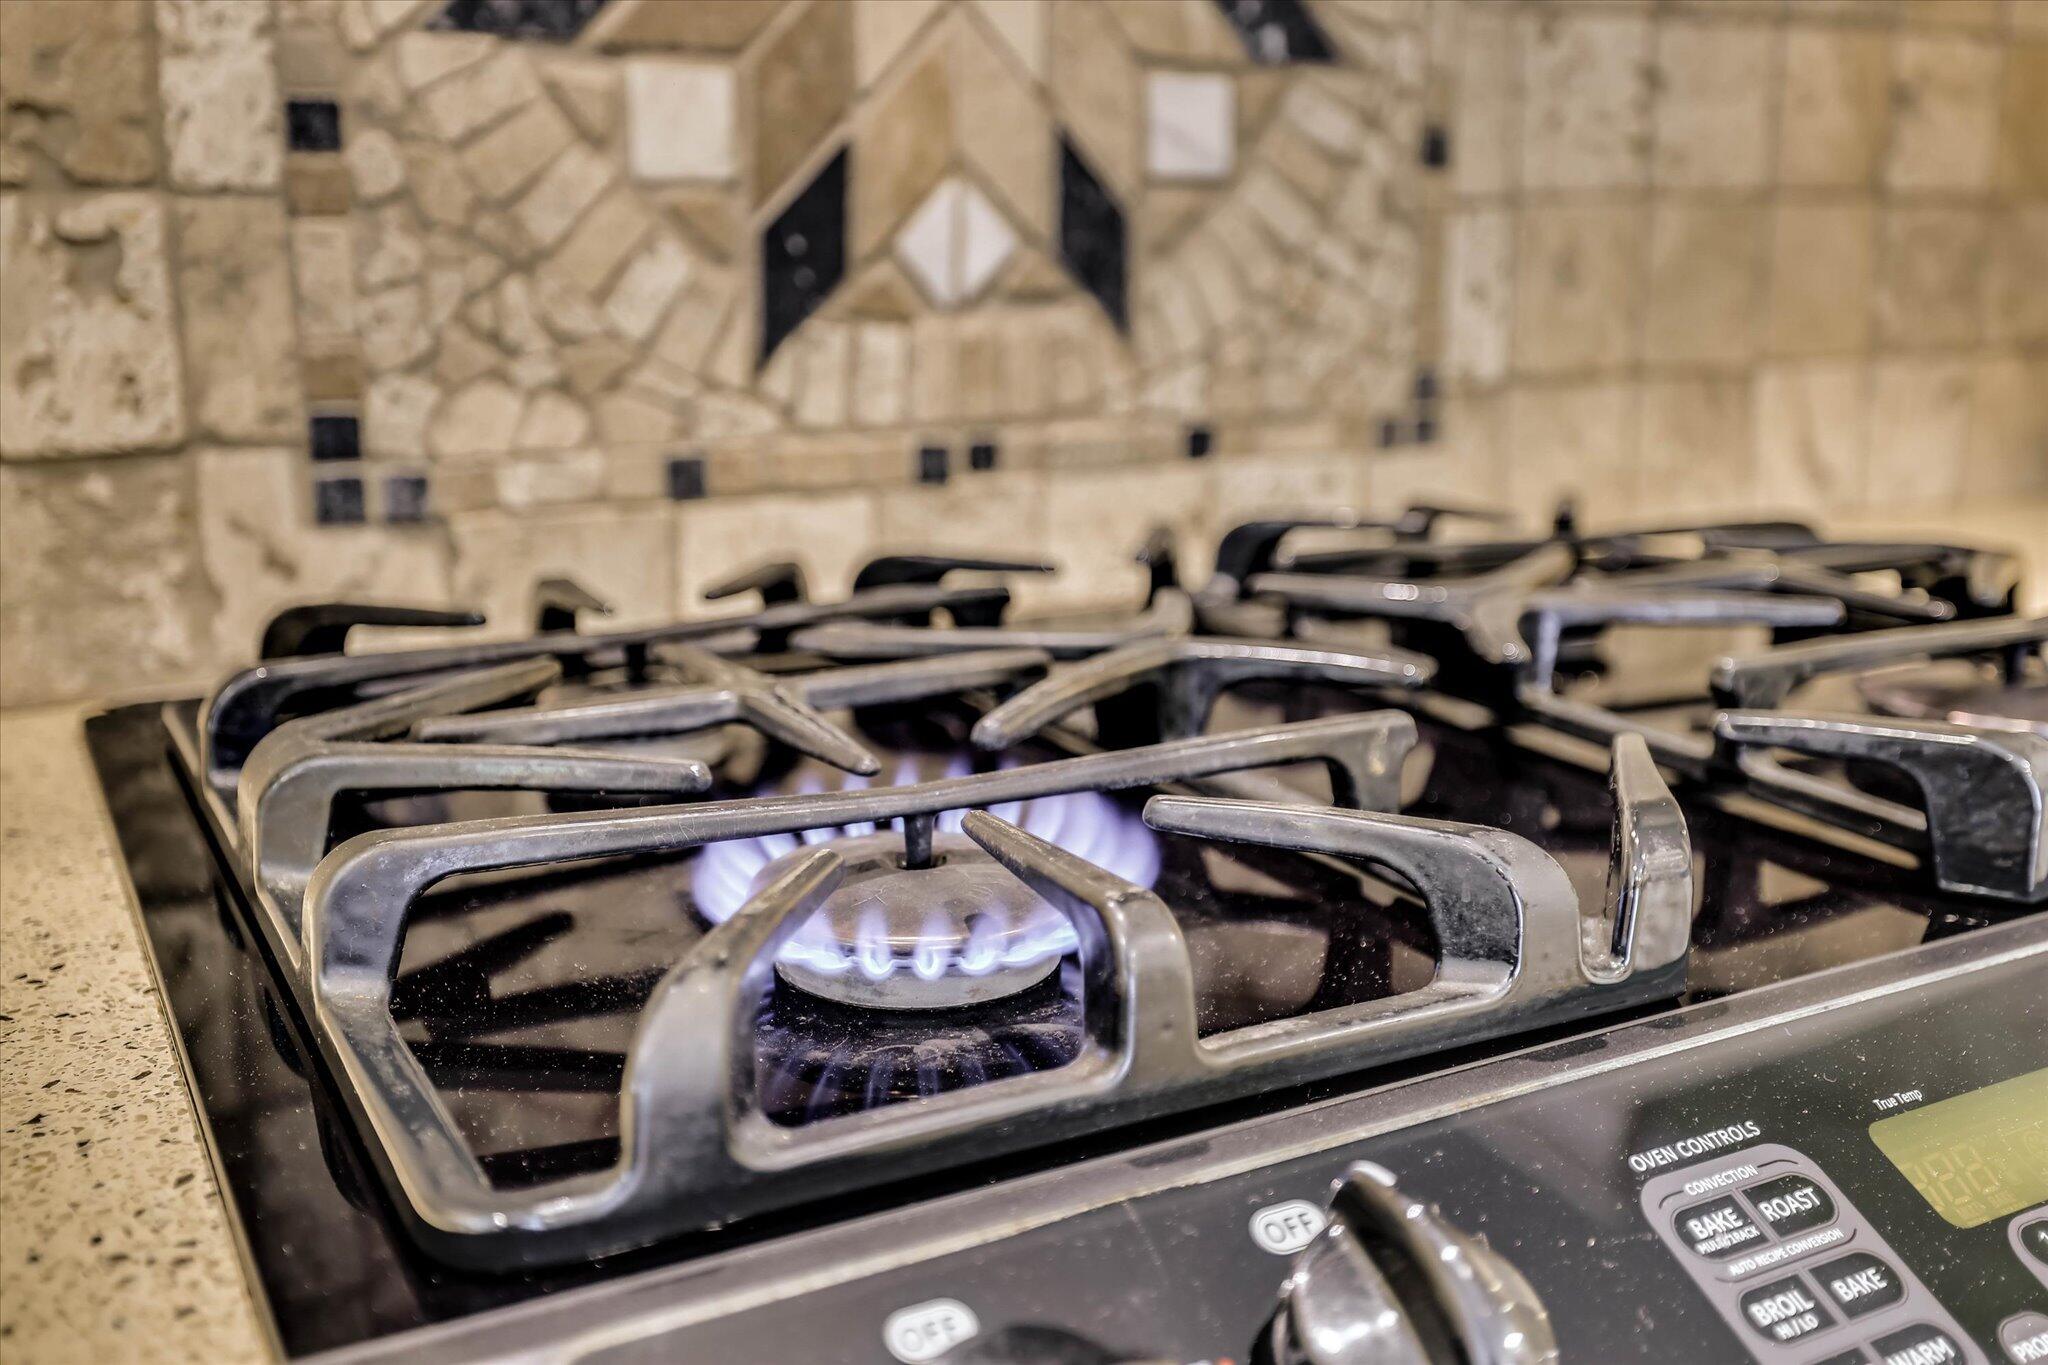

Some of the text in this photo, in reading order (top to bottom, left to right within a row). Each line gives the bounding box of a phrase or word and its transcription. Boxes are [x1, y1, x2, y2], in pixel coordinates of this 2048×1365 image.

[1873, 1089, 1923, 1110] True Temp
[1629, 1121, 1761, 1172] OVEN CONTROLS
[1684, 1165, 1758, 1196] CONVECTION
[1758, 1187, 1821, 1222] ROAST
[1264, 1211, 1313, 1244] OFF
[1687, 1207, 1743, 1240] BAKE
[1729, 1229, 1844, 1276] AUTO RECIPE CONVERSION
[1832, 1267, 1888, 1303] BAKE
[1748, 1290, 1815, 1327] BROIL
[899, 1316, 957, 1353] OFF
[1886, 1336, 1955, 1365] WARM
